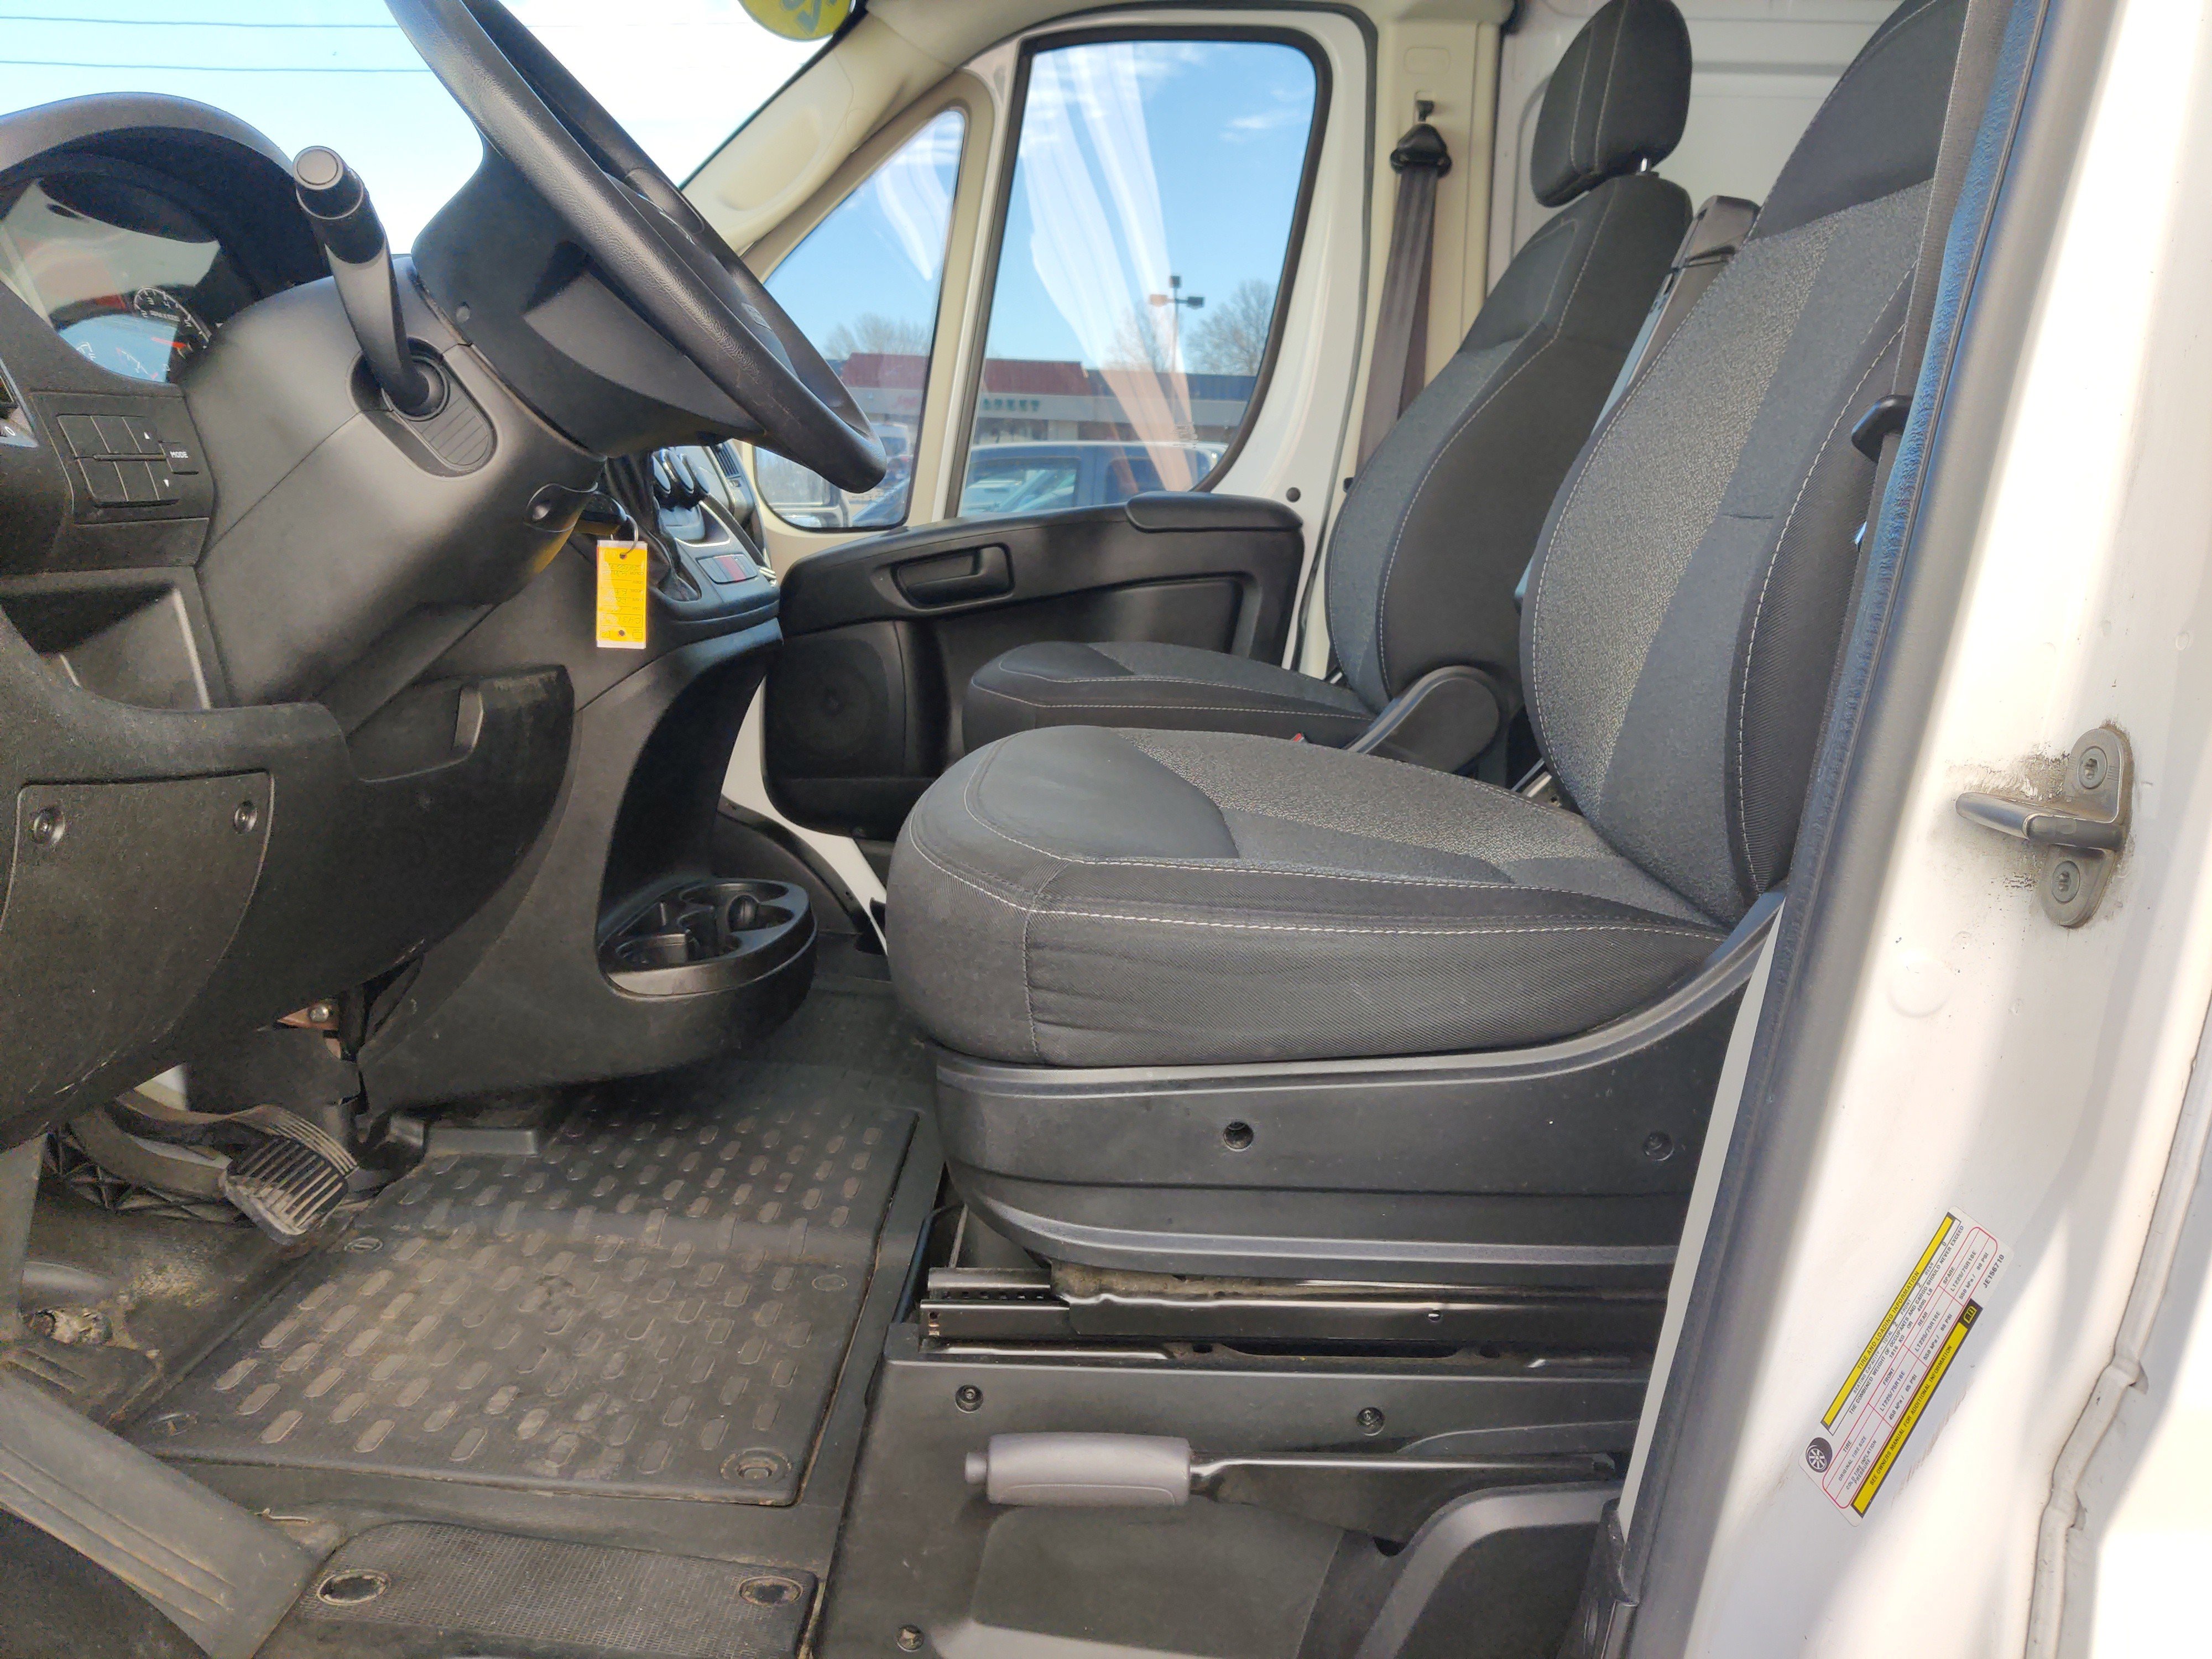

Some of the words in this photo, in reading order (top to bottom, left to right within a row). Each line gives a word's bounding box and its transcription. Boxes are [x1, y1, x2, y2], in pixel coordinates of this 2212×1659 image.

[1942, 1265, 1955, 1285] SPARE
[1982, 1253, 2005, 1288] JE156710
[1849, 1403, 1857, 1415] THE
[1855, 1376, 1874, 1404] COMBINED
[1872, 1355, 1886, 1376] WEIGHT
[1884, 1347, 1891, 1355] OF
[1888, 1316, 1910, 1348] OCCUPANTS
[1907, 1304, 1917, 1317] AND
[1914, 1285, 1928, 1305] CARGO
[1926, 1264, 1941, 1286] SHOULD
[1939, 1245, 1952, 1265] NEVER
[1950, 1224, 1964, 1246] EXCEED
[1853, 1373, 1866, 1394] SEATING
[1865, 1350, 1880, 1374] CAPACITY
[1882, 1329, 1892, 1344] TOTAL
[1900, 1298, 1912, 1315] FRONT
[1924, 1261, 1934, 1276] REAR
[1857, 1354, 1868, 1370] TIRE
[1866, 1340, 1877, 1355] AND
[1875, 1312, 1893, 1341] LOADING
[1891, 1270, 1919, 1313] INFORMATION
[1898, 1334, 1905, 1343] KG
[1926, 1287, 1933, 1296] LB
[1917, 1311, 1928, 1327] REAR
[1944, 1312, 1953, 1324] PSI
[1882, 1366, 1895, 1386] FRONT
[1909, 1373, 1917, 1384] PSI
[1869, 1474, 1877, 1486] SEE
[1876, 1449, 1892, 1475] OWNERS
[1889, 1427, 1905, 1451] MANUAL
[1902, 1414, 1912, 1427] FOR
[1910, 1382, 1931, 1415] ADDITIONAL
[1928, 1344, 1952, 1383] INFORMATION
[1838, 1458, 1853, 1482] ORIGINAL
[1851, 1446, 1860, 1459] TIRE
[1858, 1435, 1866, 1448] SIZE
[1842, 1439, 1852, 1453] TIRE
[1845, 1475, 1855, 1490] COLD
[1854, 1464, 1862, 1476] TIRE
[1860, 1438, 1877, 1465] INFLATION
[1854, 1457, 1871, 1485] PRESSURE
